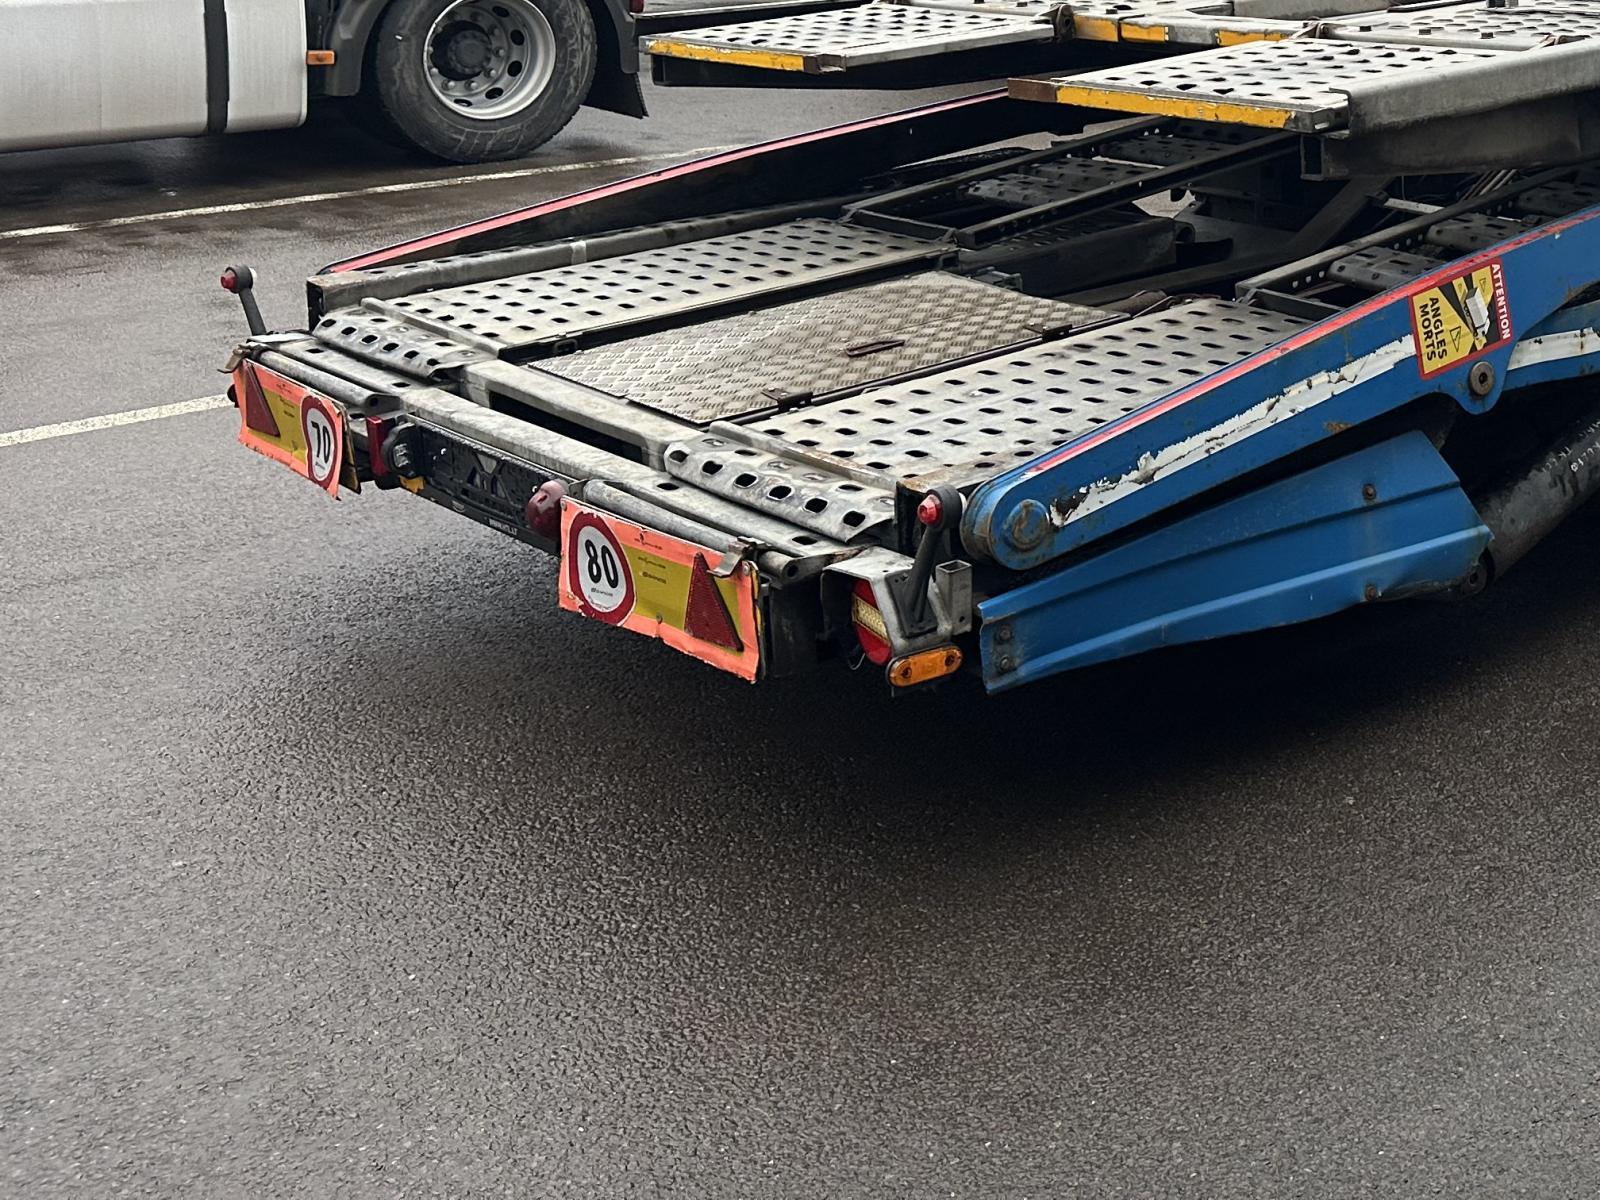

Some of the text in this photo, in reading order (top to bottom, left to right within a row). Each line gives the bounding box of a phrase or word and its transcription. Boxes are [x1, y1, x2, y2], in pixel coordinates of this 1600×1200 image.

[1429, 297, 1447, 360] ANGLES
[1491, 263, 1511, 340] ATTENTION
[1419, 303, 1436, 361] MORTS
[311, 420, 331, 464] 70
[584, 539, 619, 589] 80
